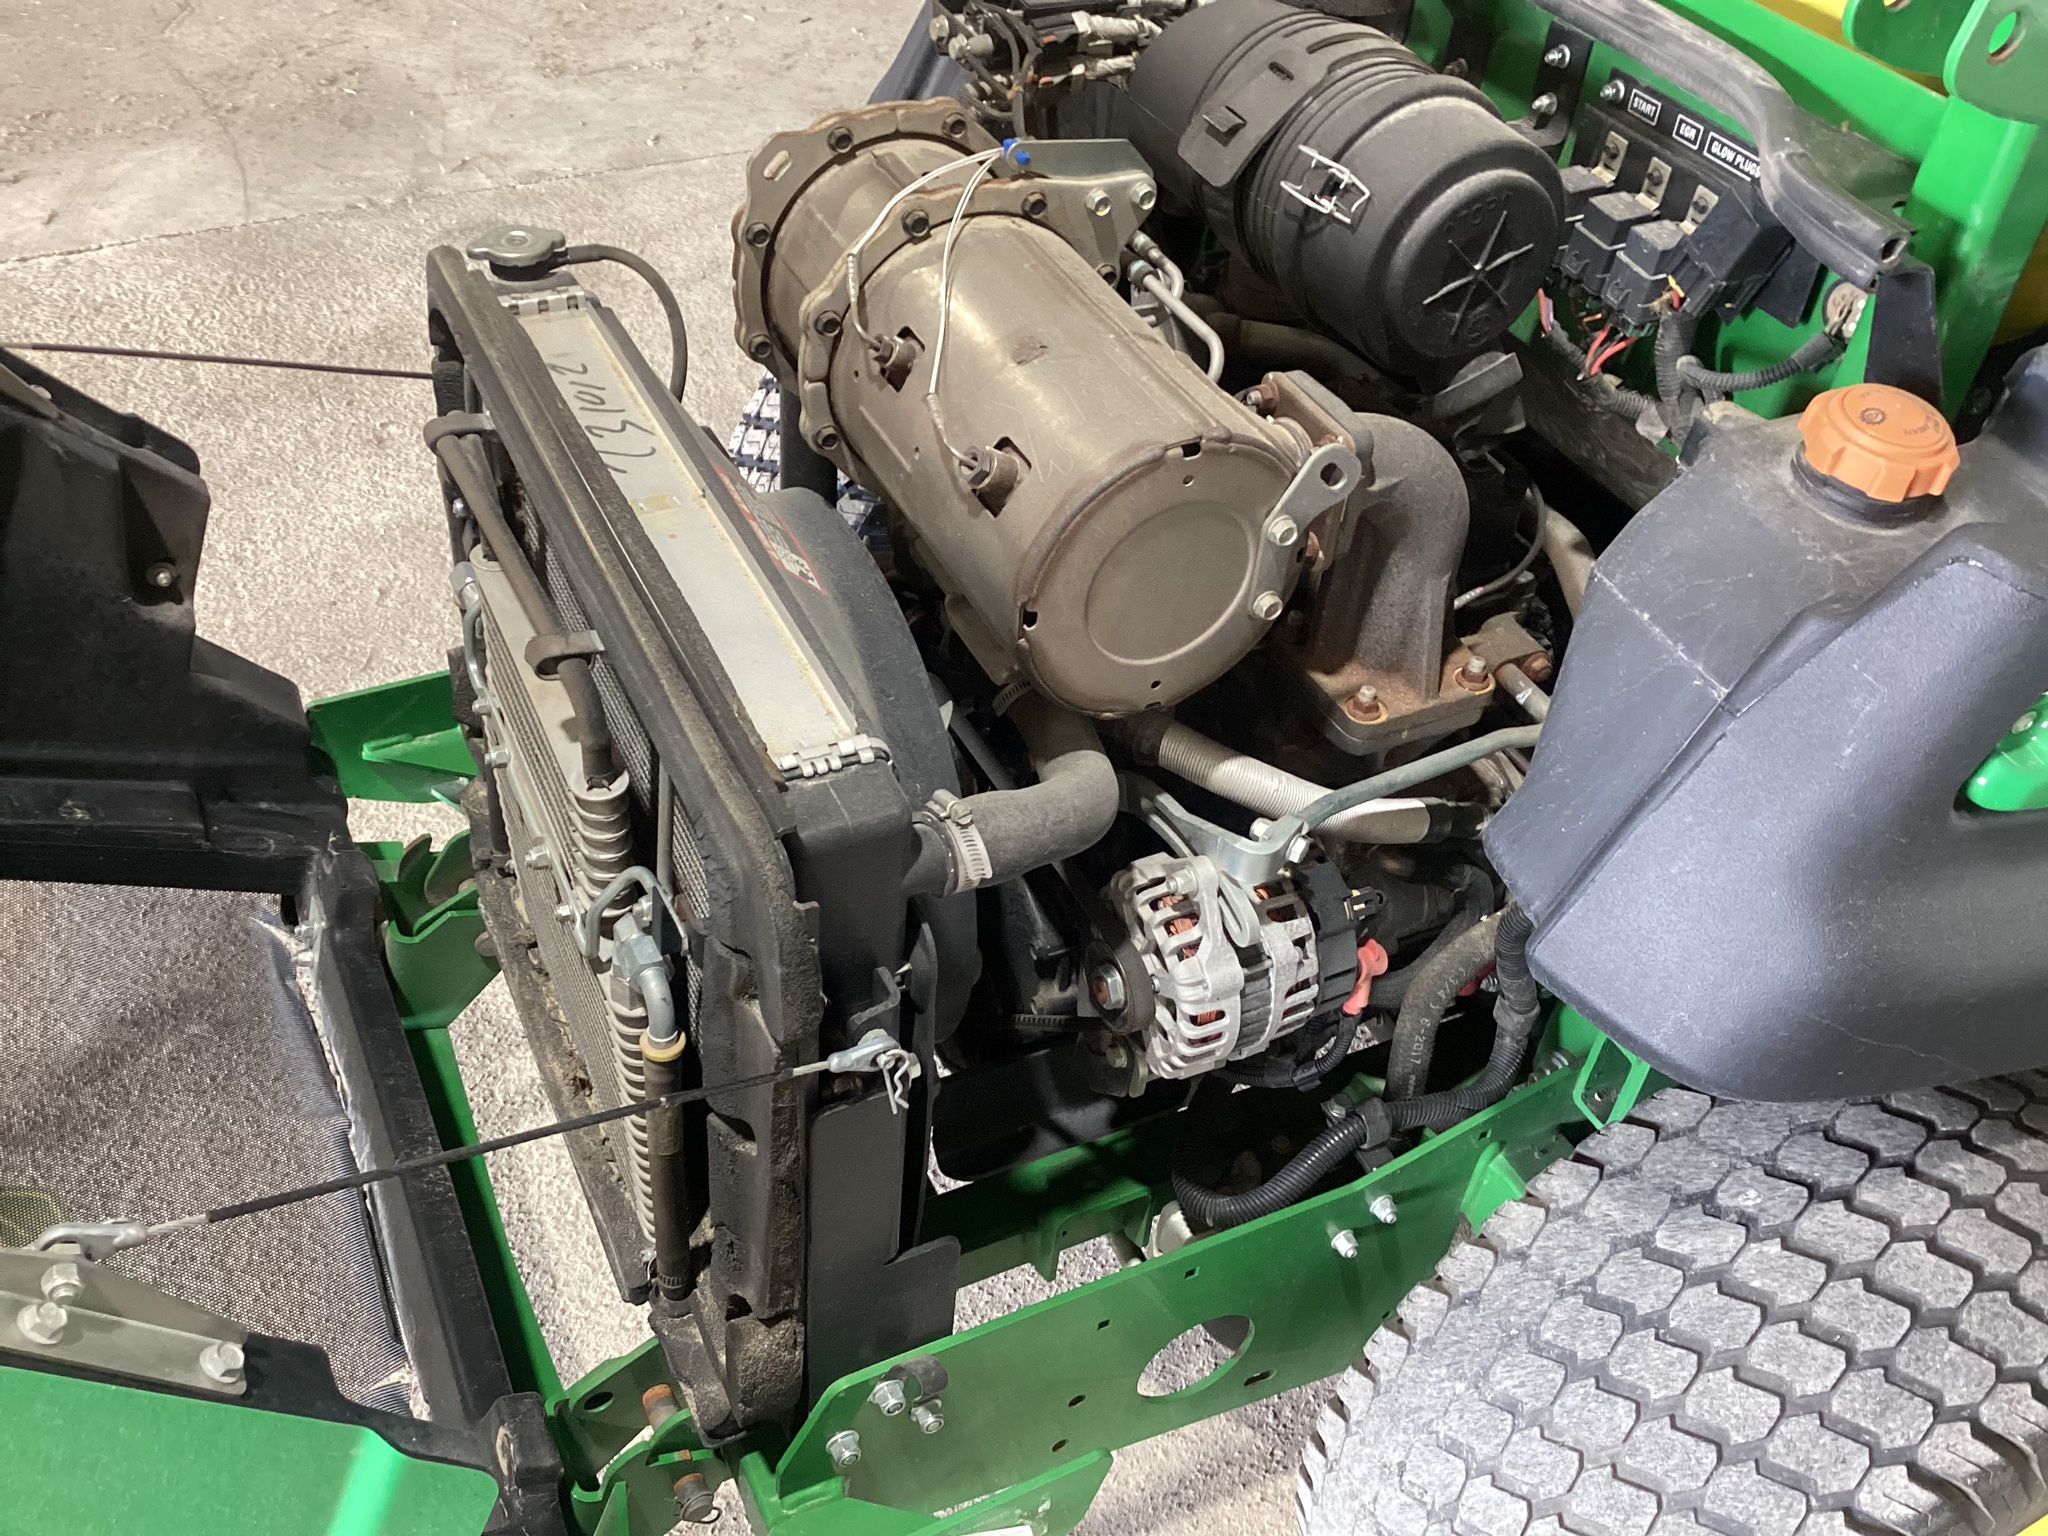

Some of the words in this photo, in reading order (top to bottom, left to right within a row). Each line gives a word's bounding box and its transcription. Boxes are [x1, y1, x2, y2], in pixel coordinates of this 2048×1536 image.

[1632, 98, 1656, 117] START
[1679, 123, 1697, 140] EGR
[1711, 141, 1735, 163] GLOW
[1735, 155, 1760, 178] PLUGS
